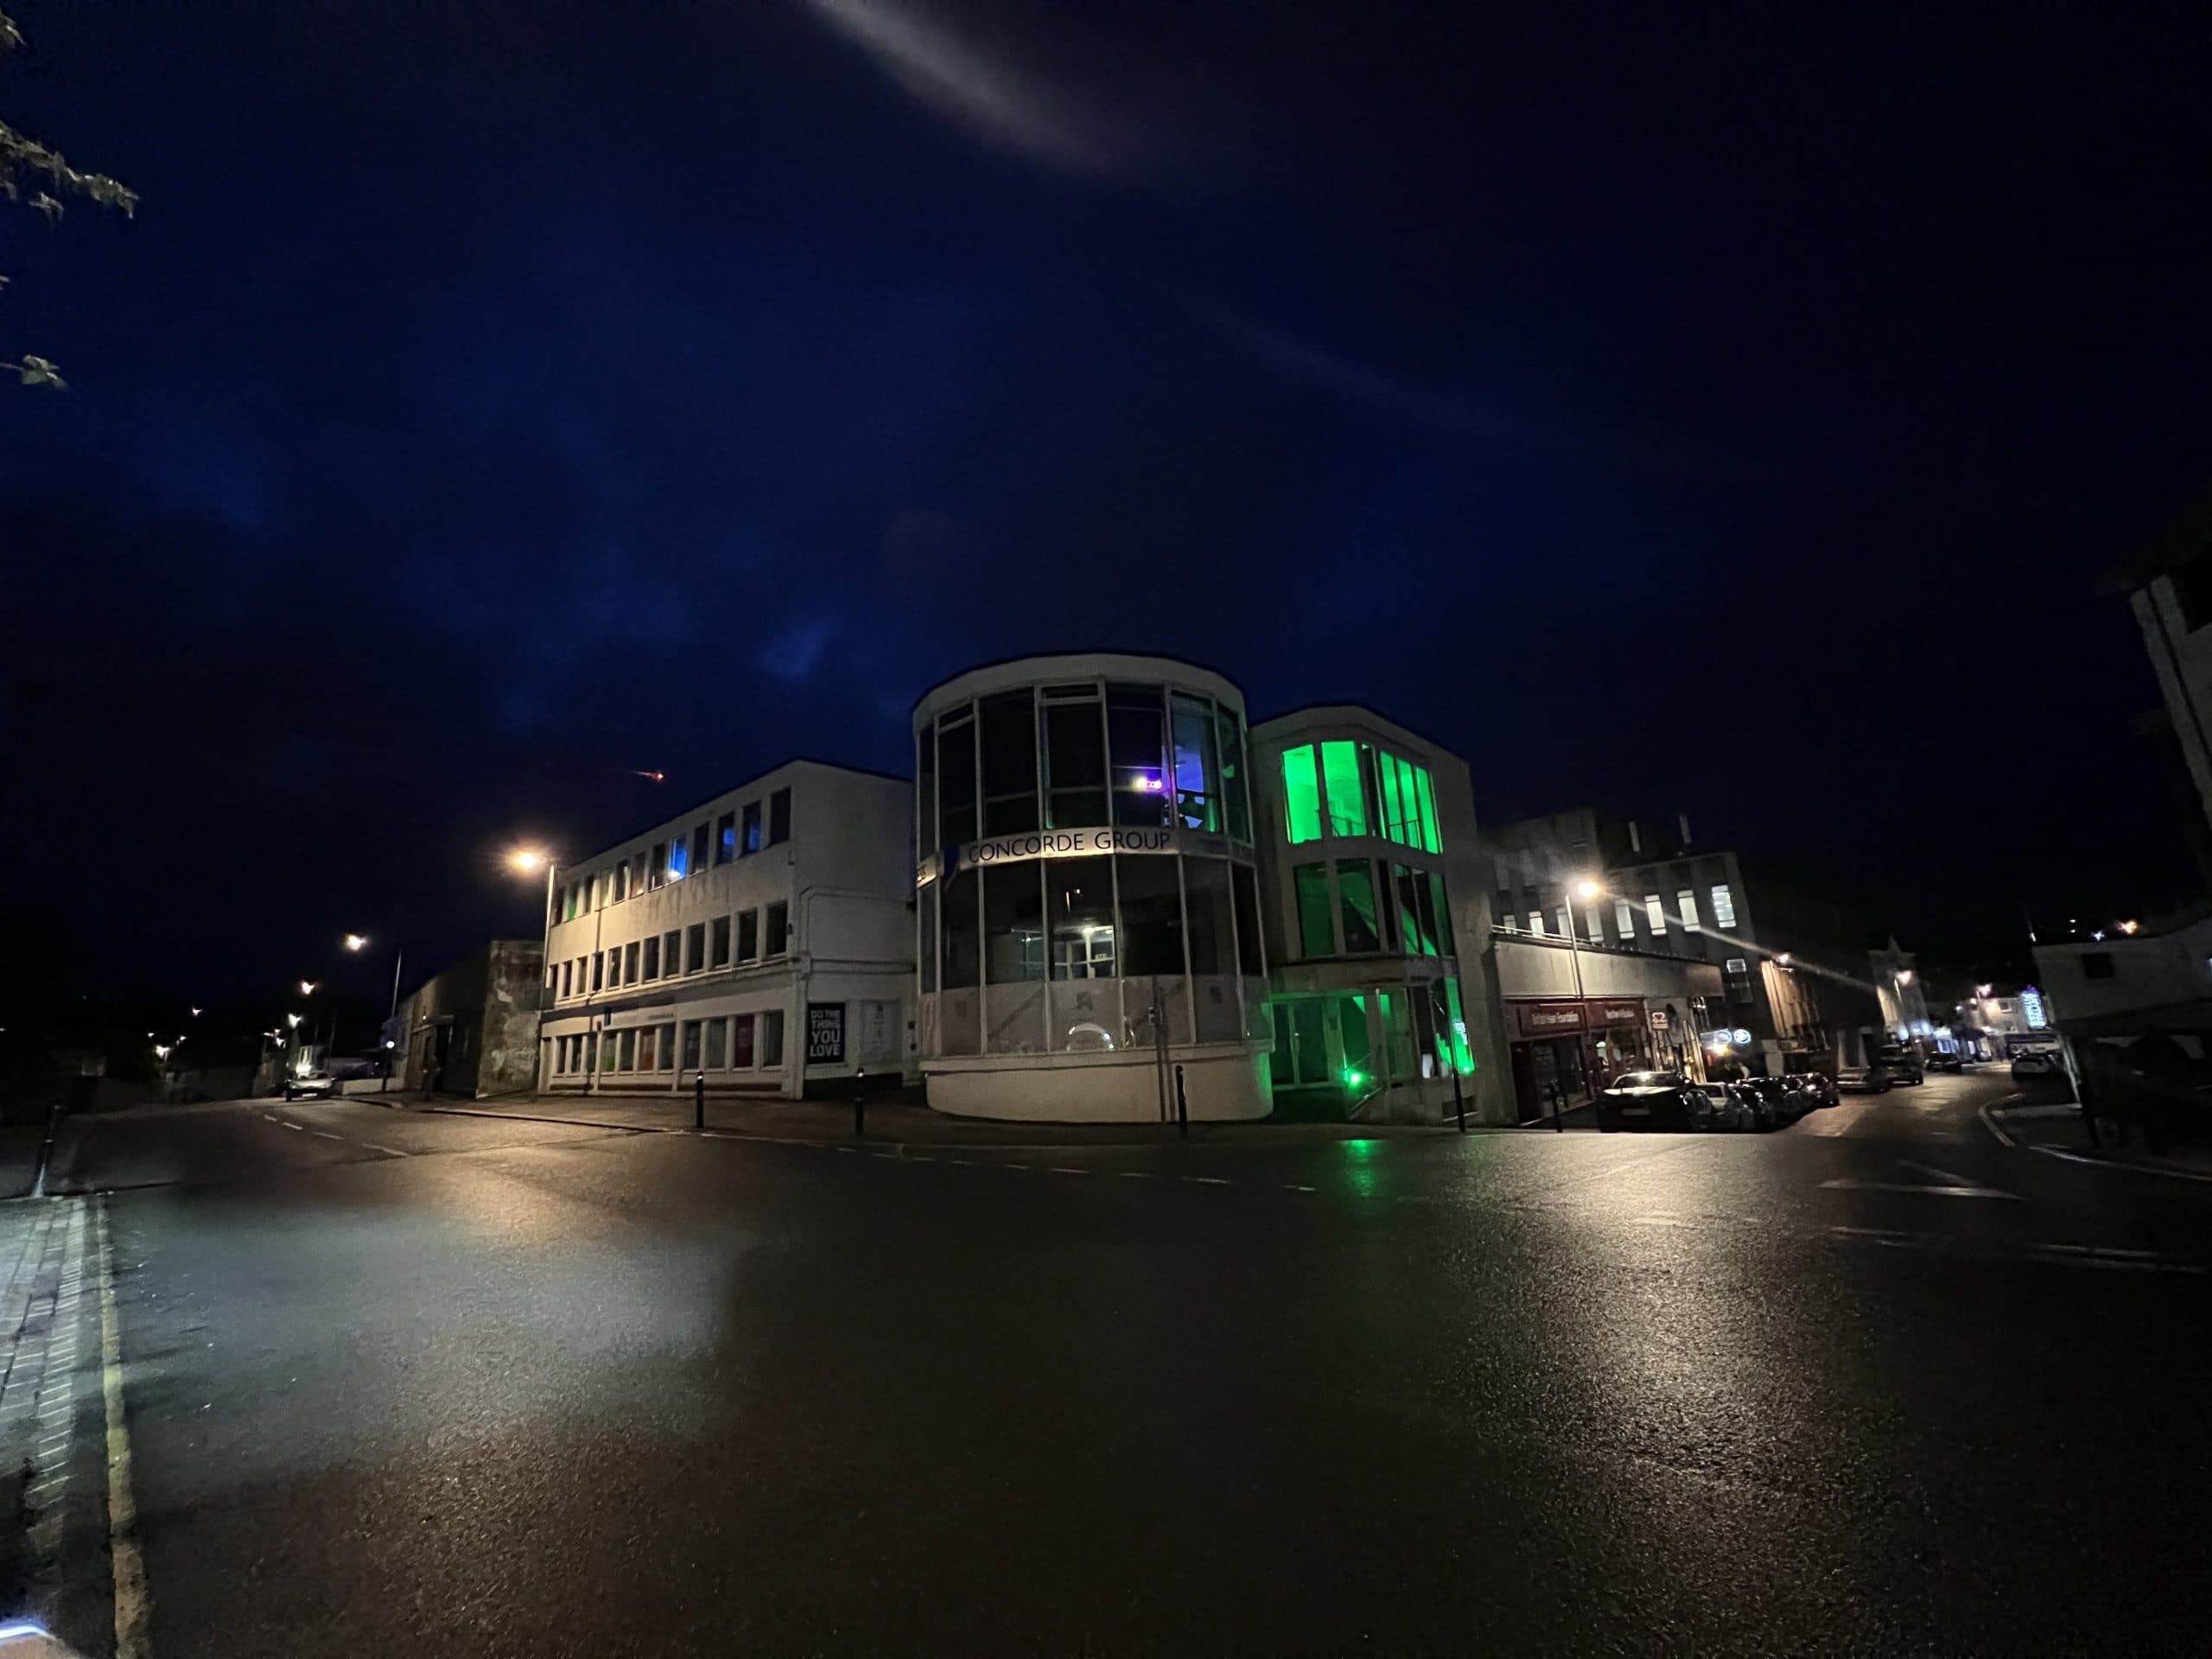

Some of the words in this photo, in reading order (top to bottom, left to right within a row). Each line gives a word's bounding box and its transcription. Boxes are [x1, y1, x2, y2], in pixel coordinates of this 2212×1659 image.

[969, 833, 1084, 863] CONCORDE
[1094, 831, 1172, 850] GROUP
[810, 1009, 823, 1020] DO
[824, 1009, 841, 1019] THE
[810, 1019, 841, 1030] THING
[810, 1030, 841, 1044] YOU
[810, 1044, 841, 1057] LOVE
